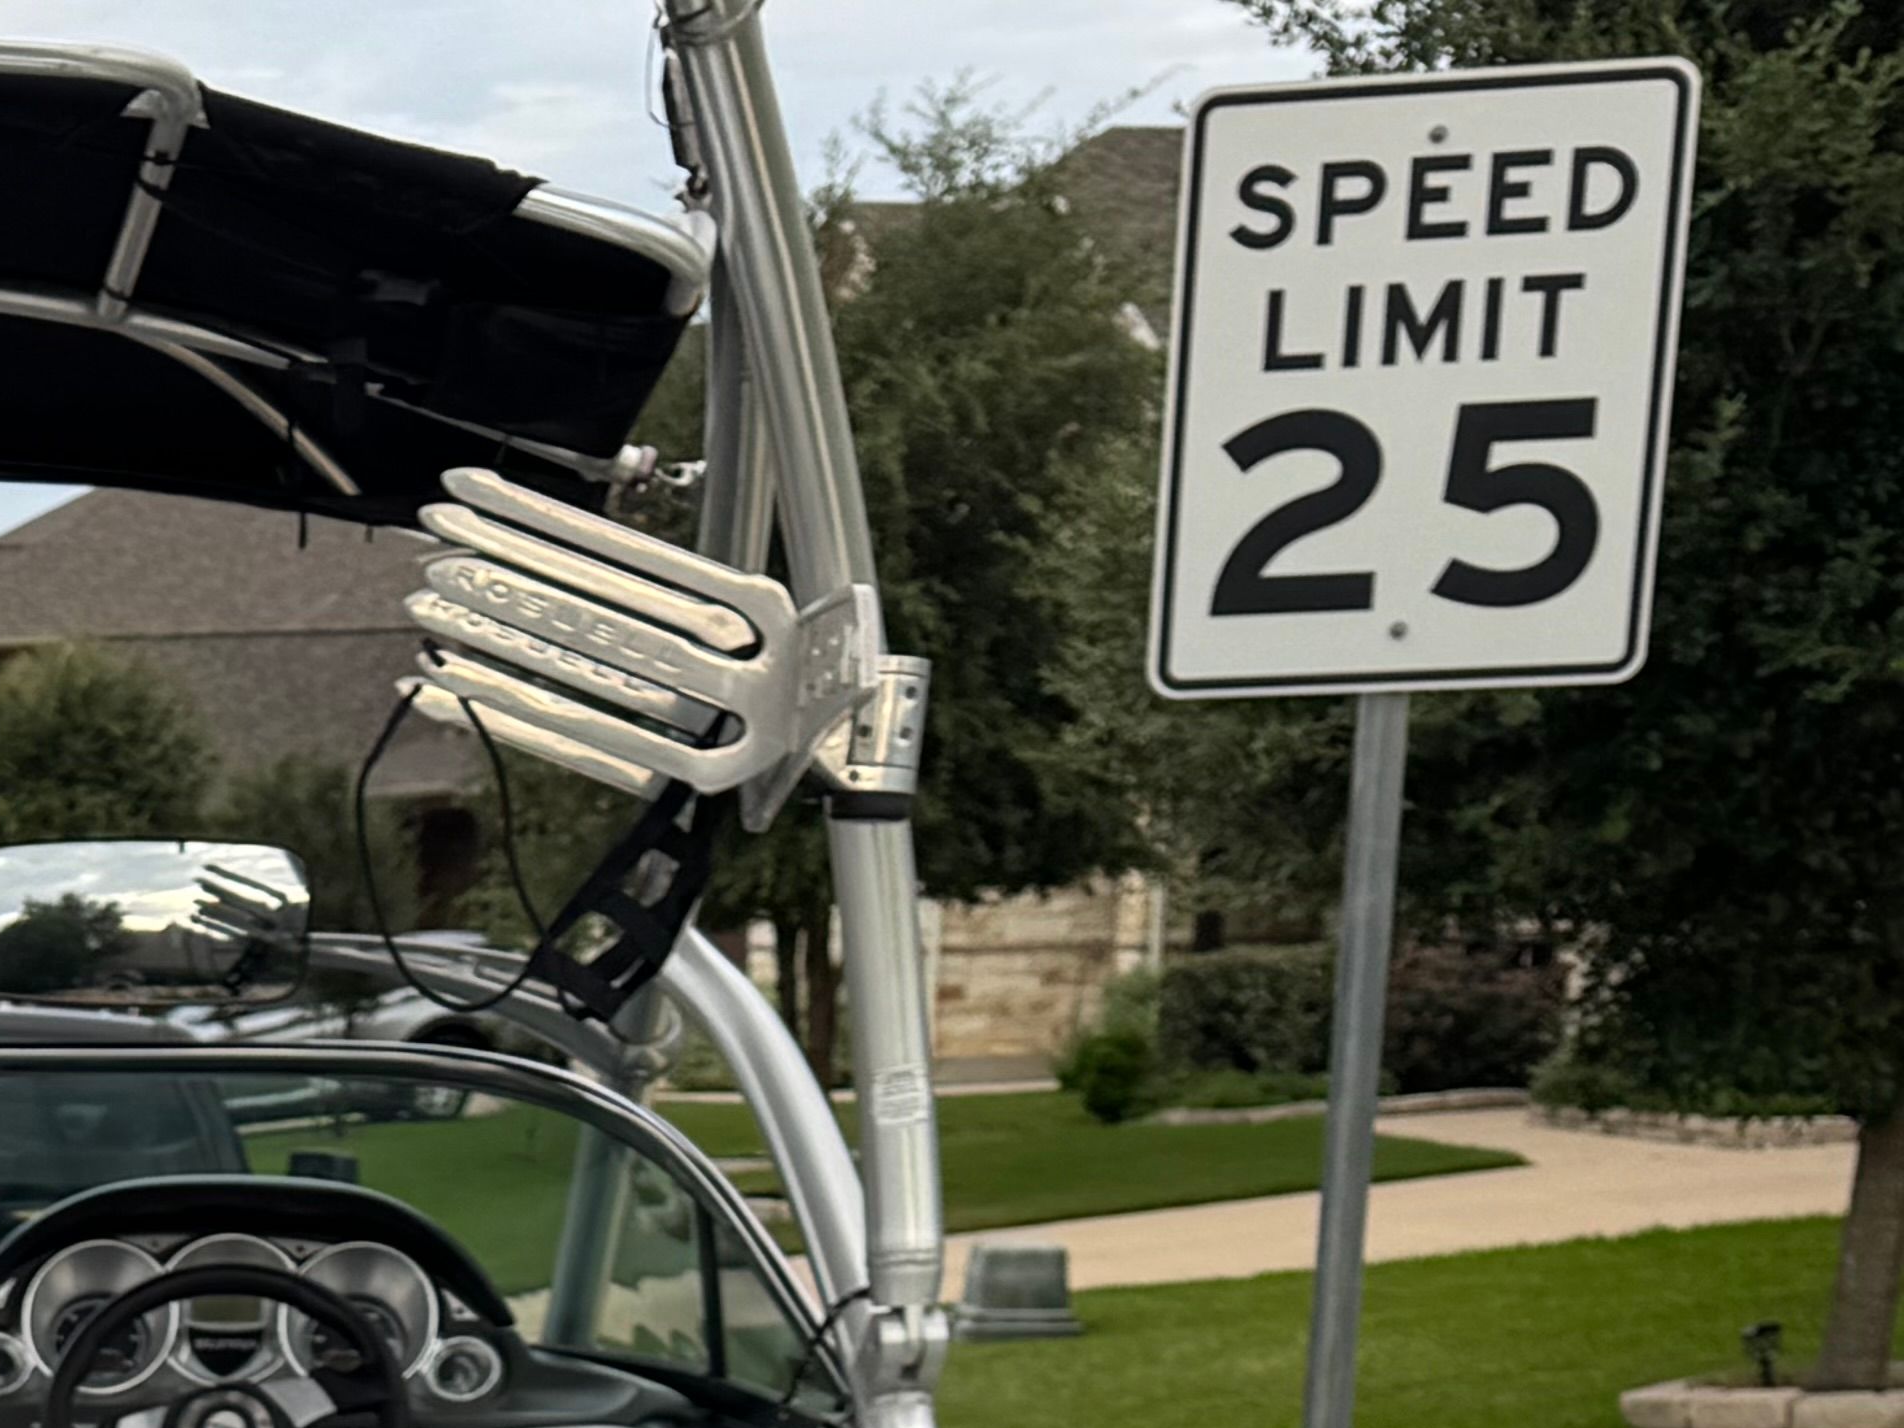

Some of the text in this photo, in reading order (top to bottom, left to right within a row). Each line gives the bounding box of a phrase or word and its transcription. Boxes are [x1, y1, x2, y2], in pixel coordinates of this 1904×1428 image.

[1230, 145, 1639, 251] SPEED
[1262, 273, 1586, 372] LIMIT
[1209, 397, 1602, 616] 25
